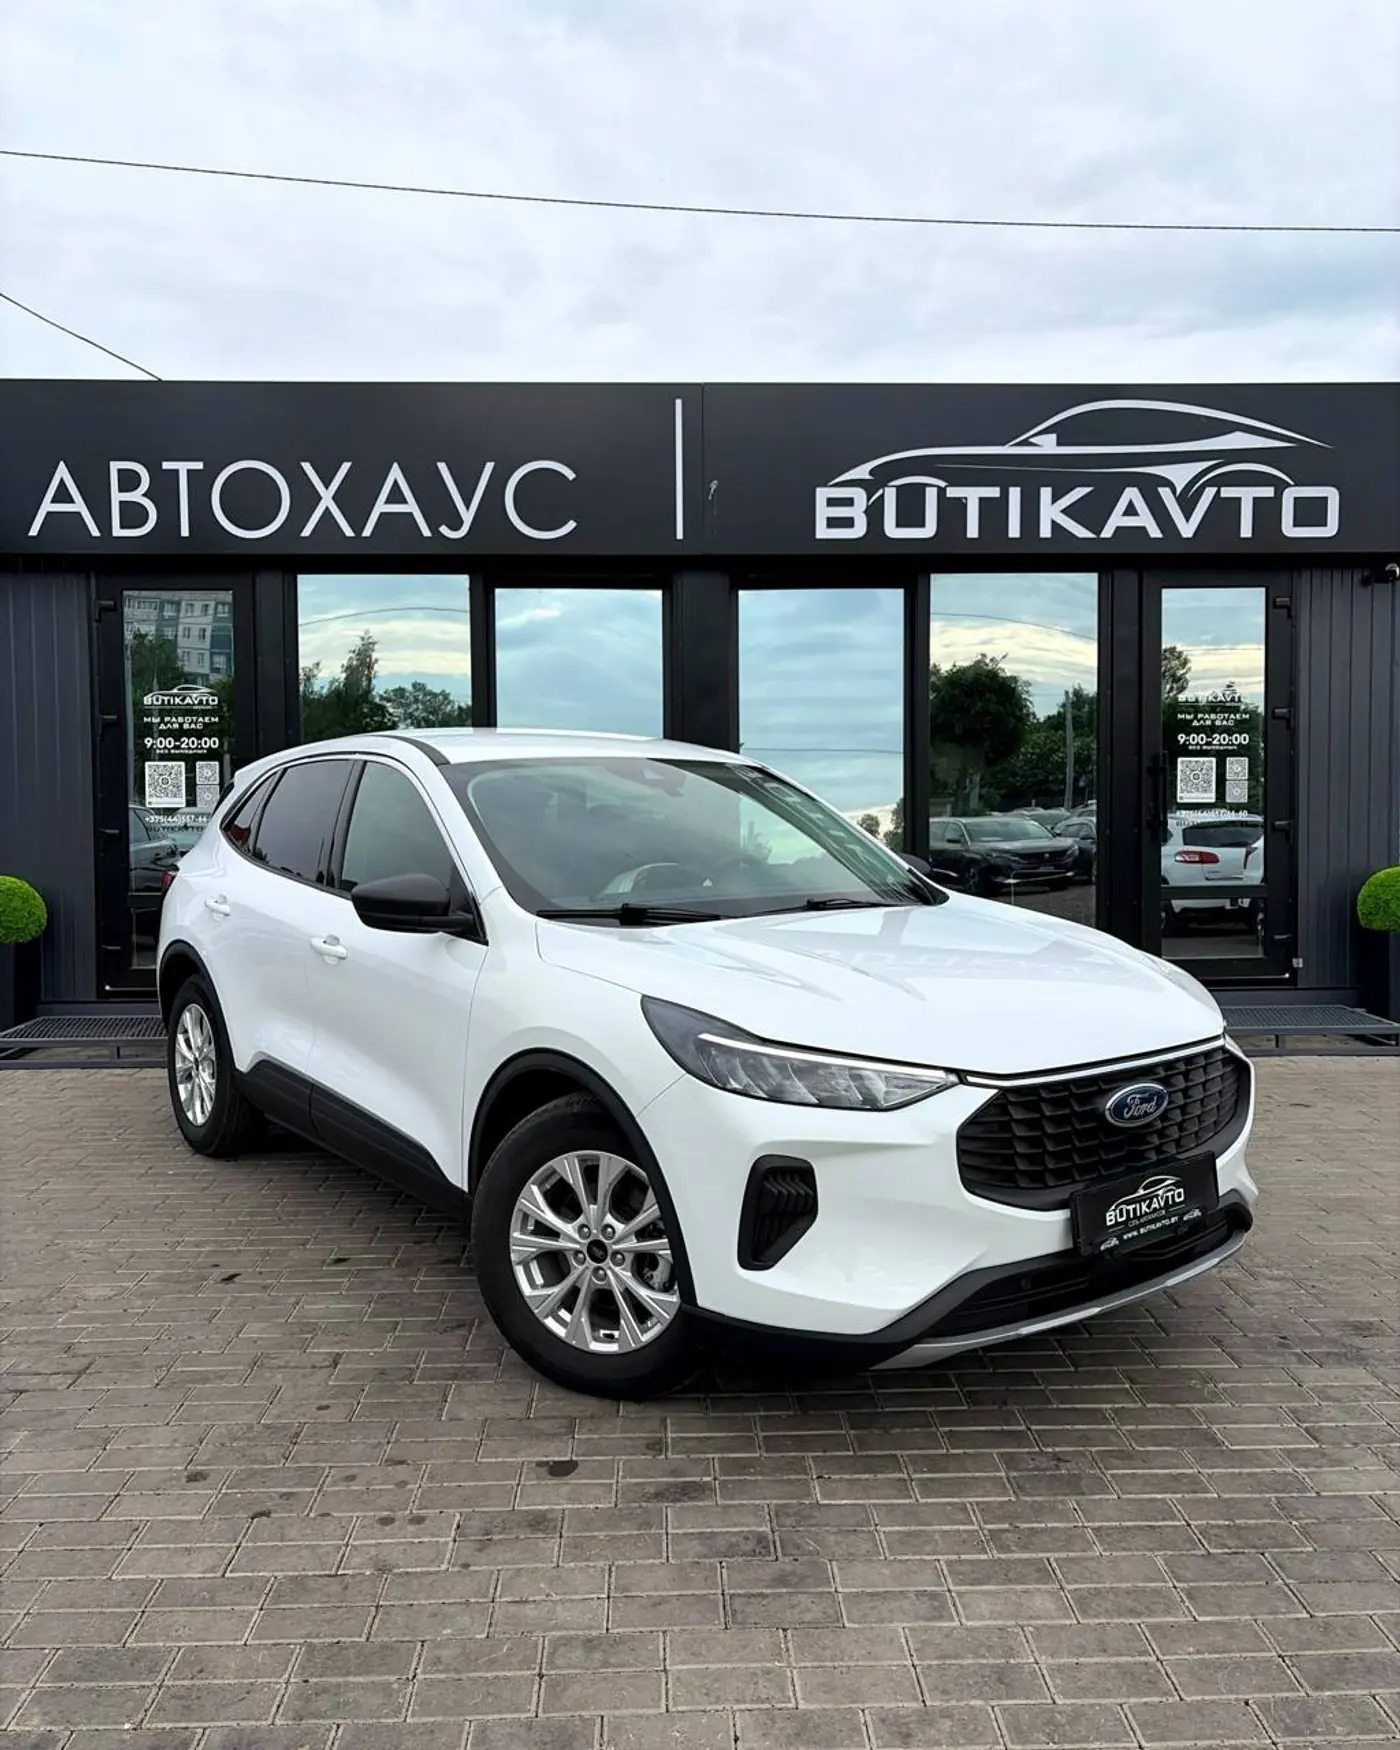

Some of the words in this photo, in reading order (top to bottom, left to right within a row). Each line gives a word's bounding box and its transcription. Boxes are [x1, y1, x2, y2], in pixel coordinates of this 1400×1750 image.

[27, 459, 578, 540] АВТОХАУС
[814, 485, 1340, 540] BUTIKAVTO
[143, 695, 219, 706] BUTIKAVTO
[144, 736, 219, 749] 9:00-20:00
[1177, 733, 1249, 745] 9:00-20:00
[1123, 1091, 1158, 1120] Ford
[1105, 1187, 1185, 1227] BUTIKAVTO
